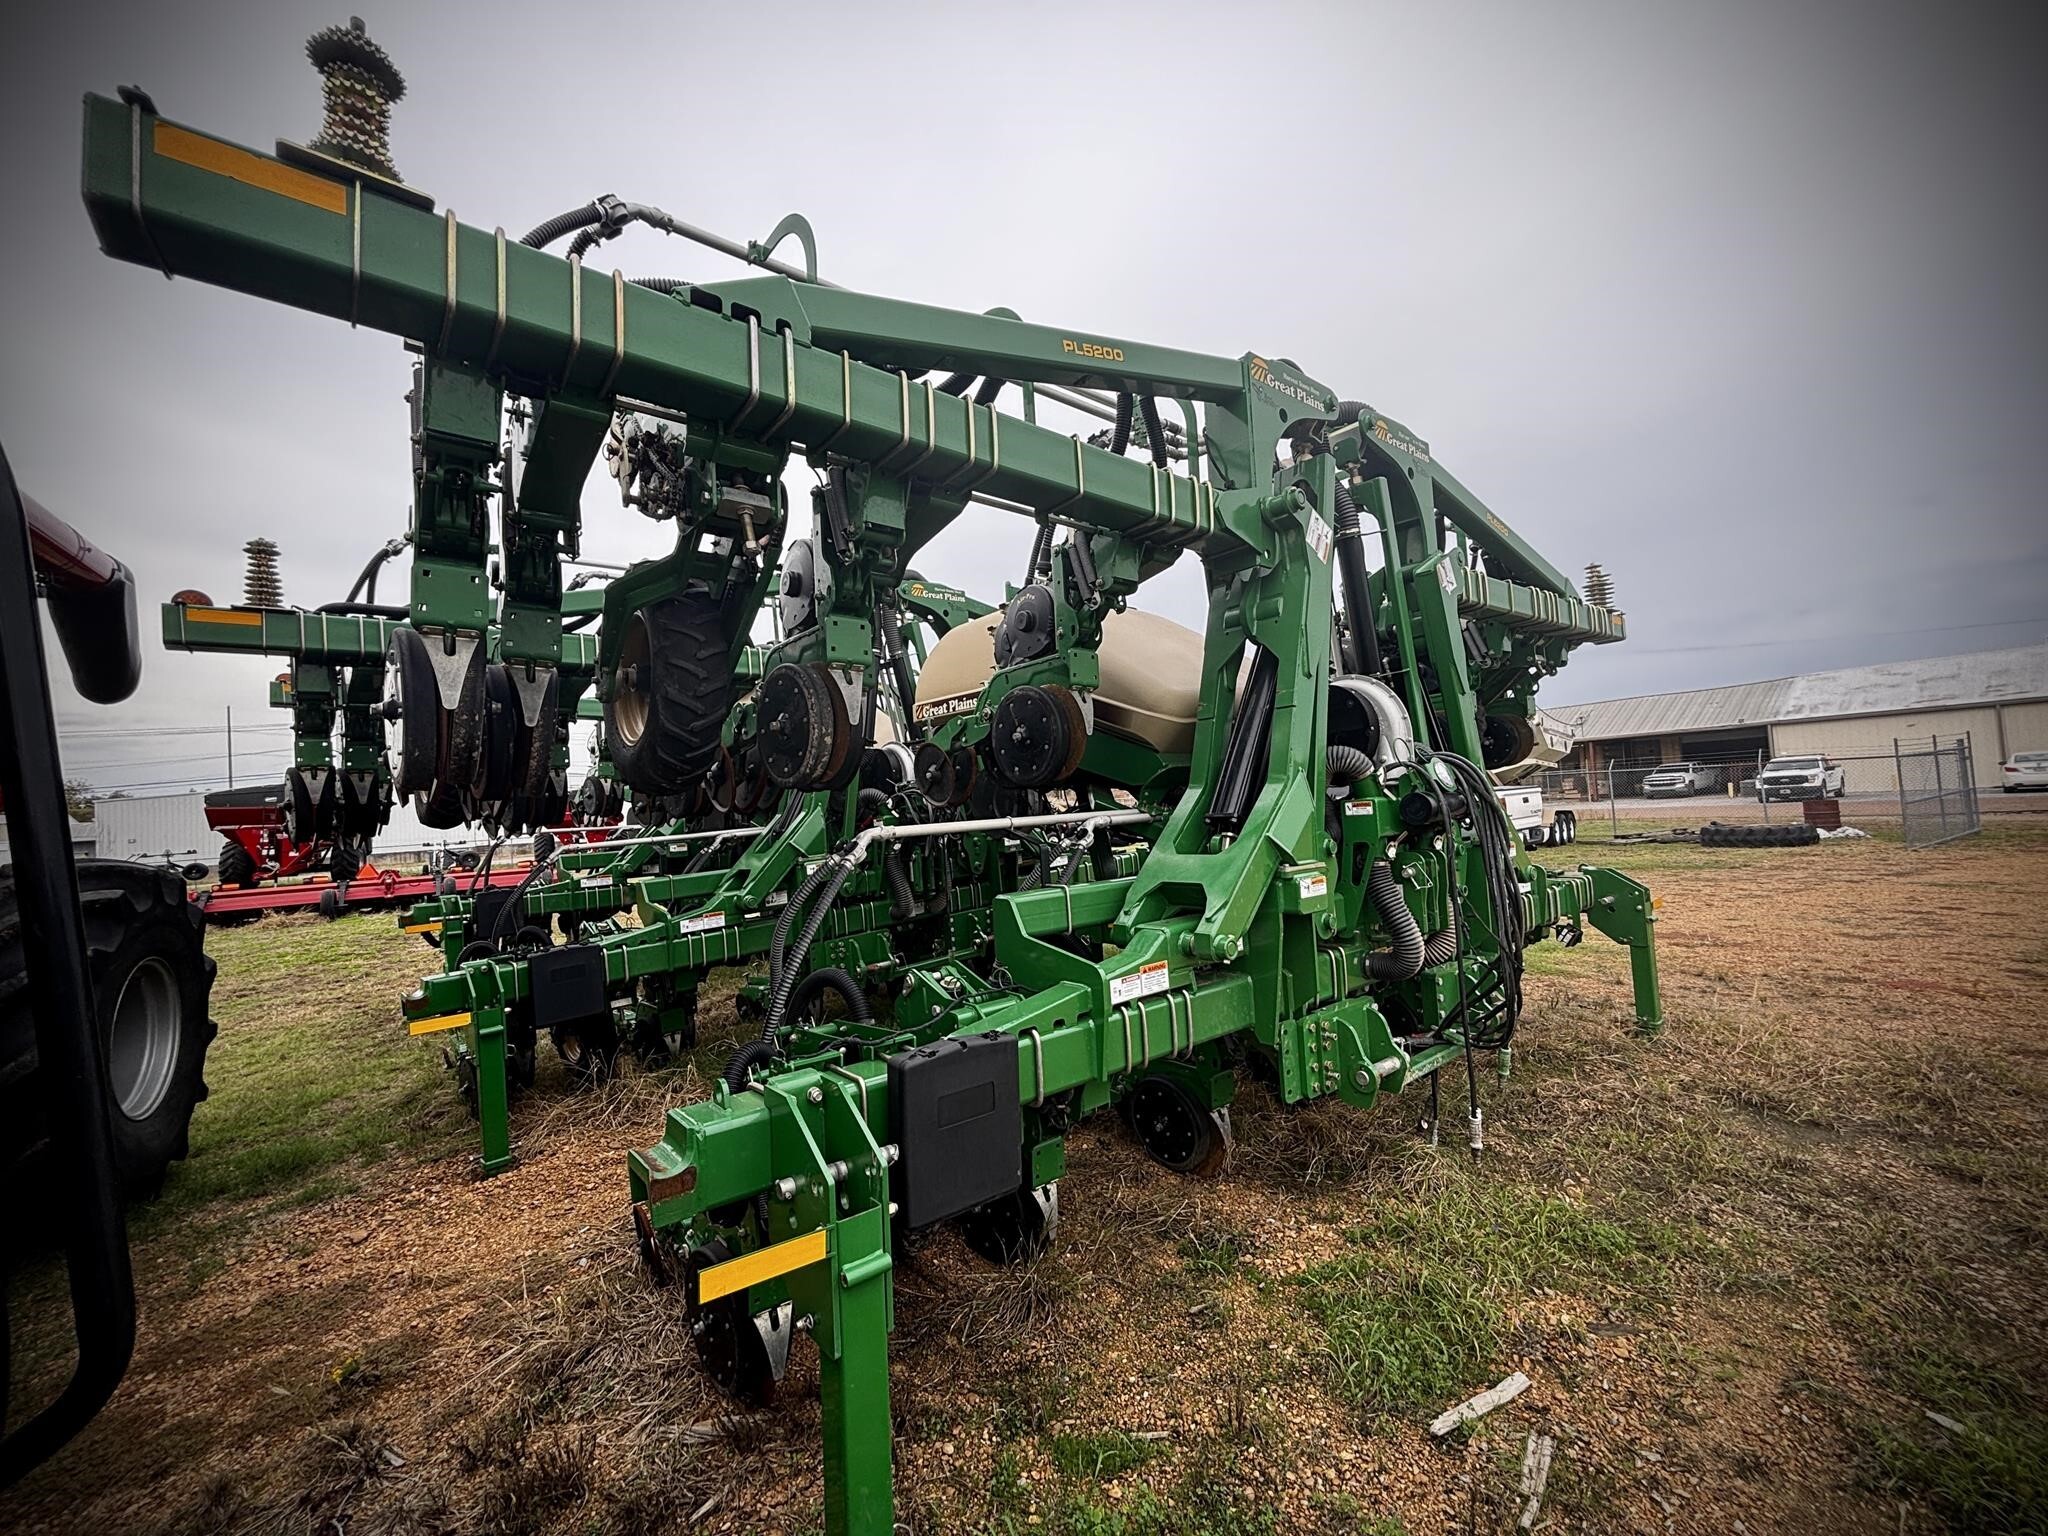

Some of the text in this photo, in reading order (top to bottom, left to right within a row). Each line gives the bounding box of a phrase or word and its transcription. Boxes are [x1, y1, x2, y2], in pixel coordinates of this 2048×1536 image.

[1063, 339, 1124, 362] PL5200
[1266, 373, 1296, 398] Great
[1297, 386, 1325, 412] Plains
[1386, 432, 1408, 452] Great
[1408, 442, 1430, 463] Plains
[922, 590, 943, 600] Great
[944, 592, 966, 603] Plains
[922, 697, 978, 717] Great Plains
